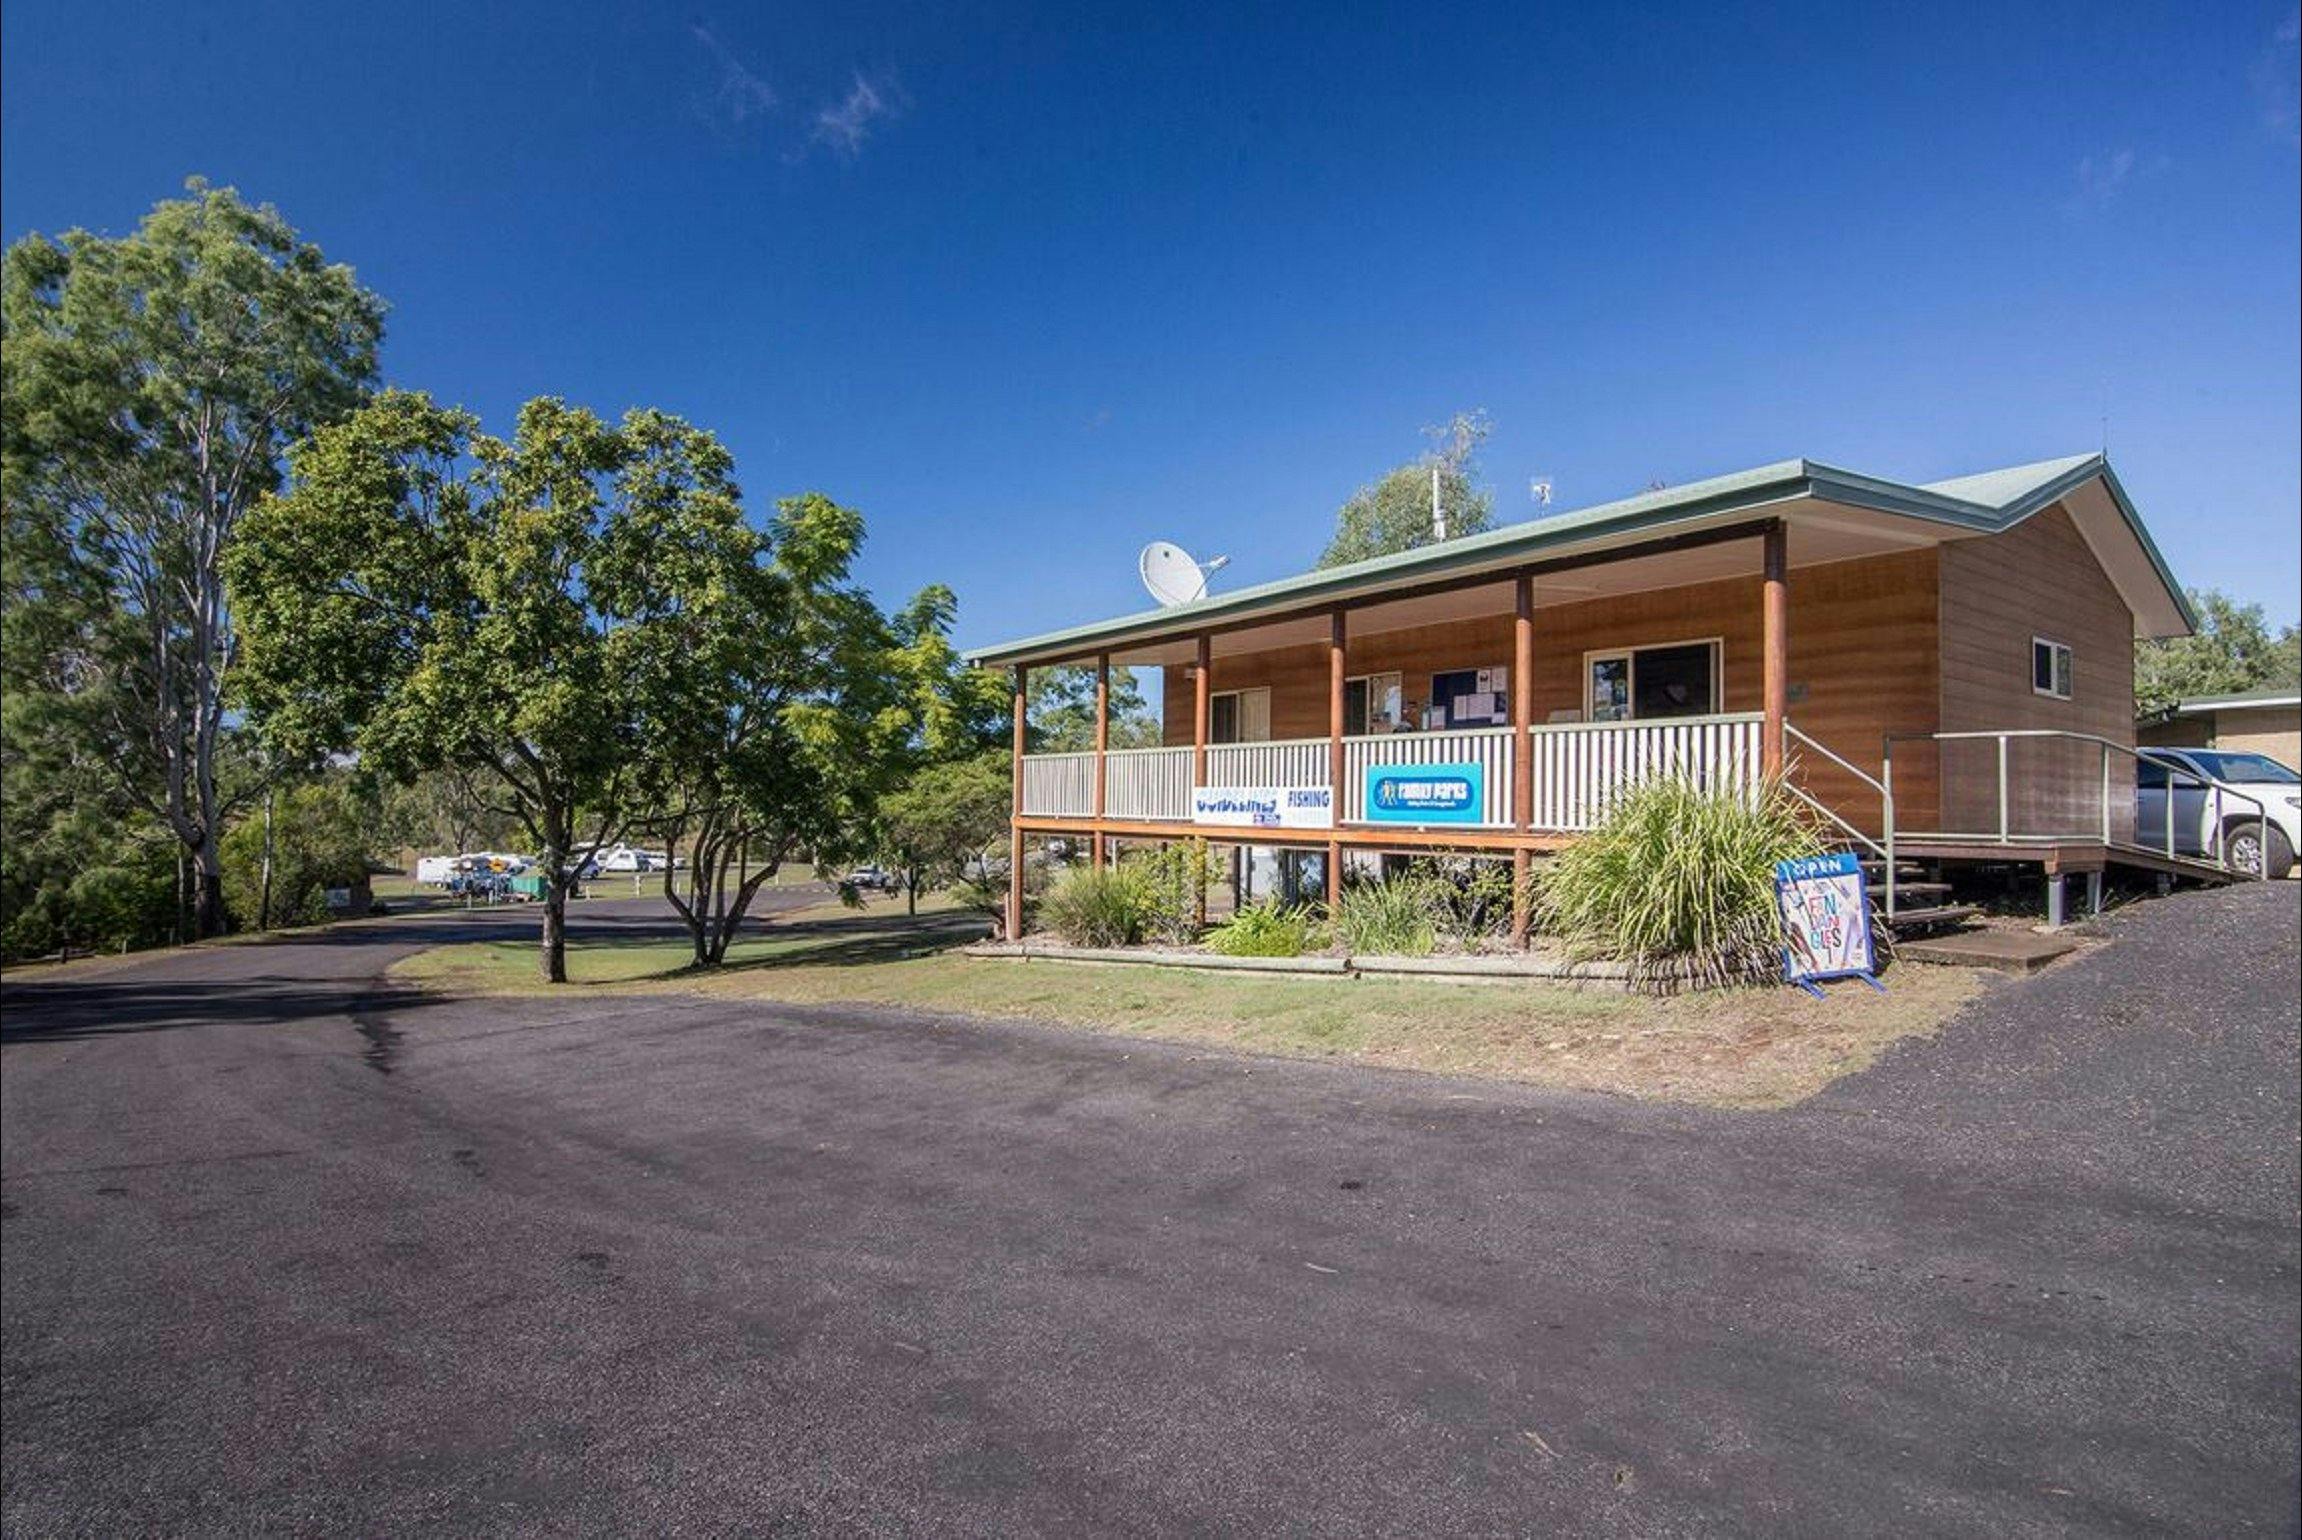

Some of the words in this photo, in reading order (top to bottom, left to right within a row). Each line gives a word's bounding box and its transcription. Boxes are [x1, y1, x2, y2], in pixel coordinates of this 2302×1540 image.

[1287, 790, 1329, 808] FISHING
[1793, 859, 1842, 876] OPEN
[1809, 893, 1836, 914] FN
